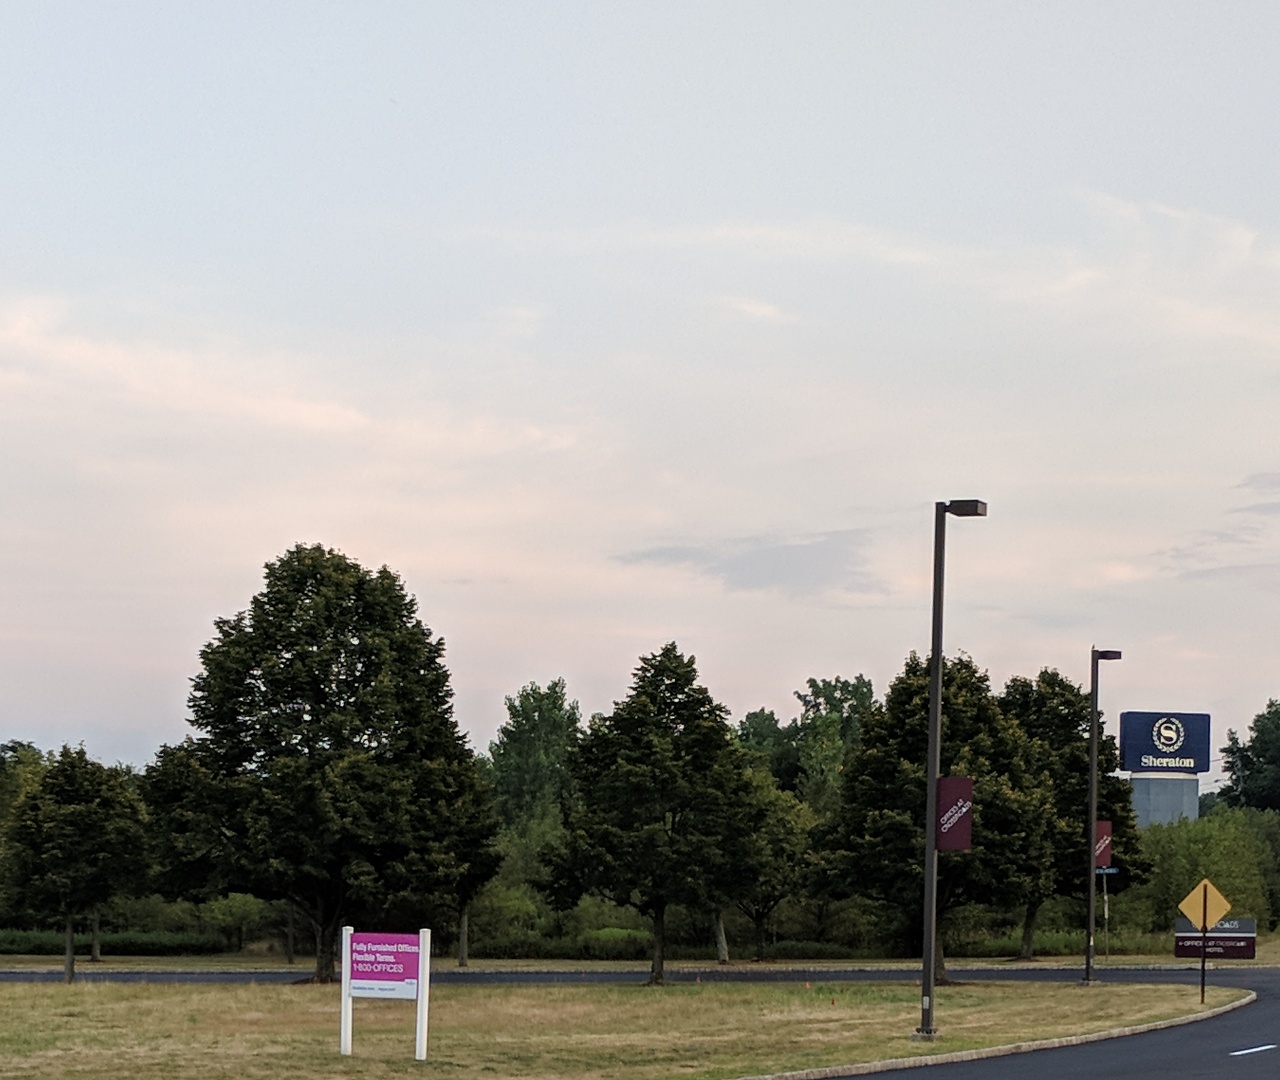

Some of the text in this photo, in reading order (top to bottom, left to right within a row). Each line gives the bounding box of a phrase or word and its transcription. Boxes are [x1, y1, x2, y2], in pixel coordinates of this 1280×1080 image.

[1160, 723, 1177, 744] S
[1141, 755, 1194, 768] Sheraton
[353, 963, 404, 972] 1-800-OFFICES
